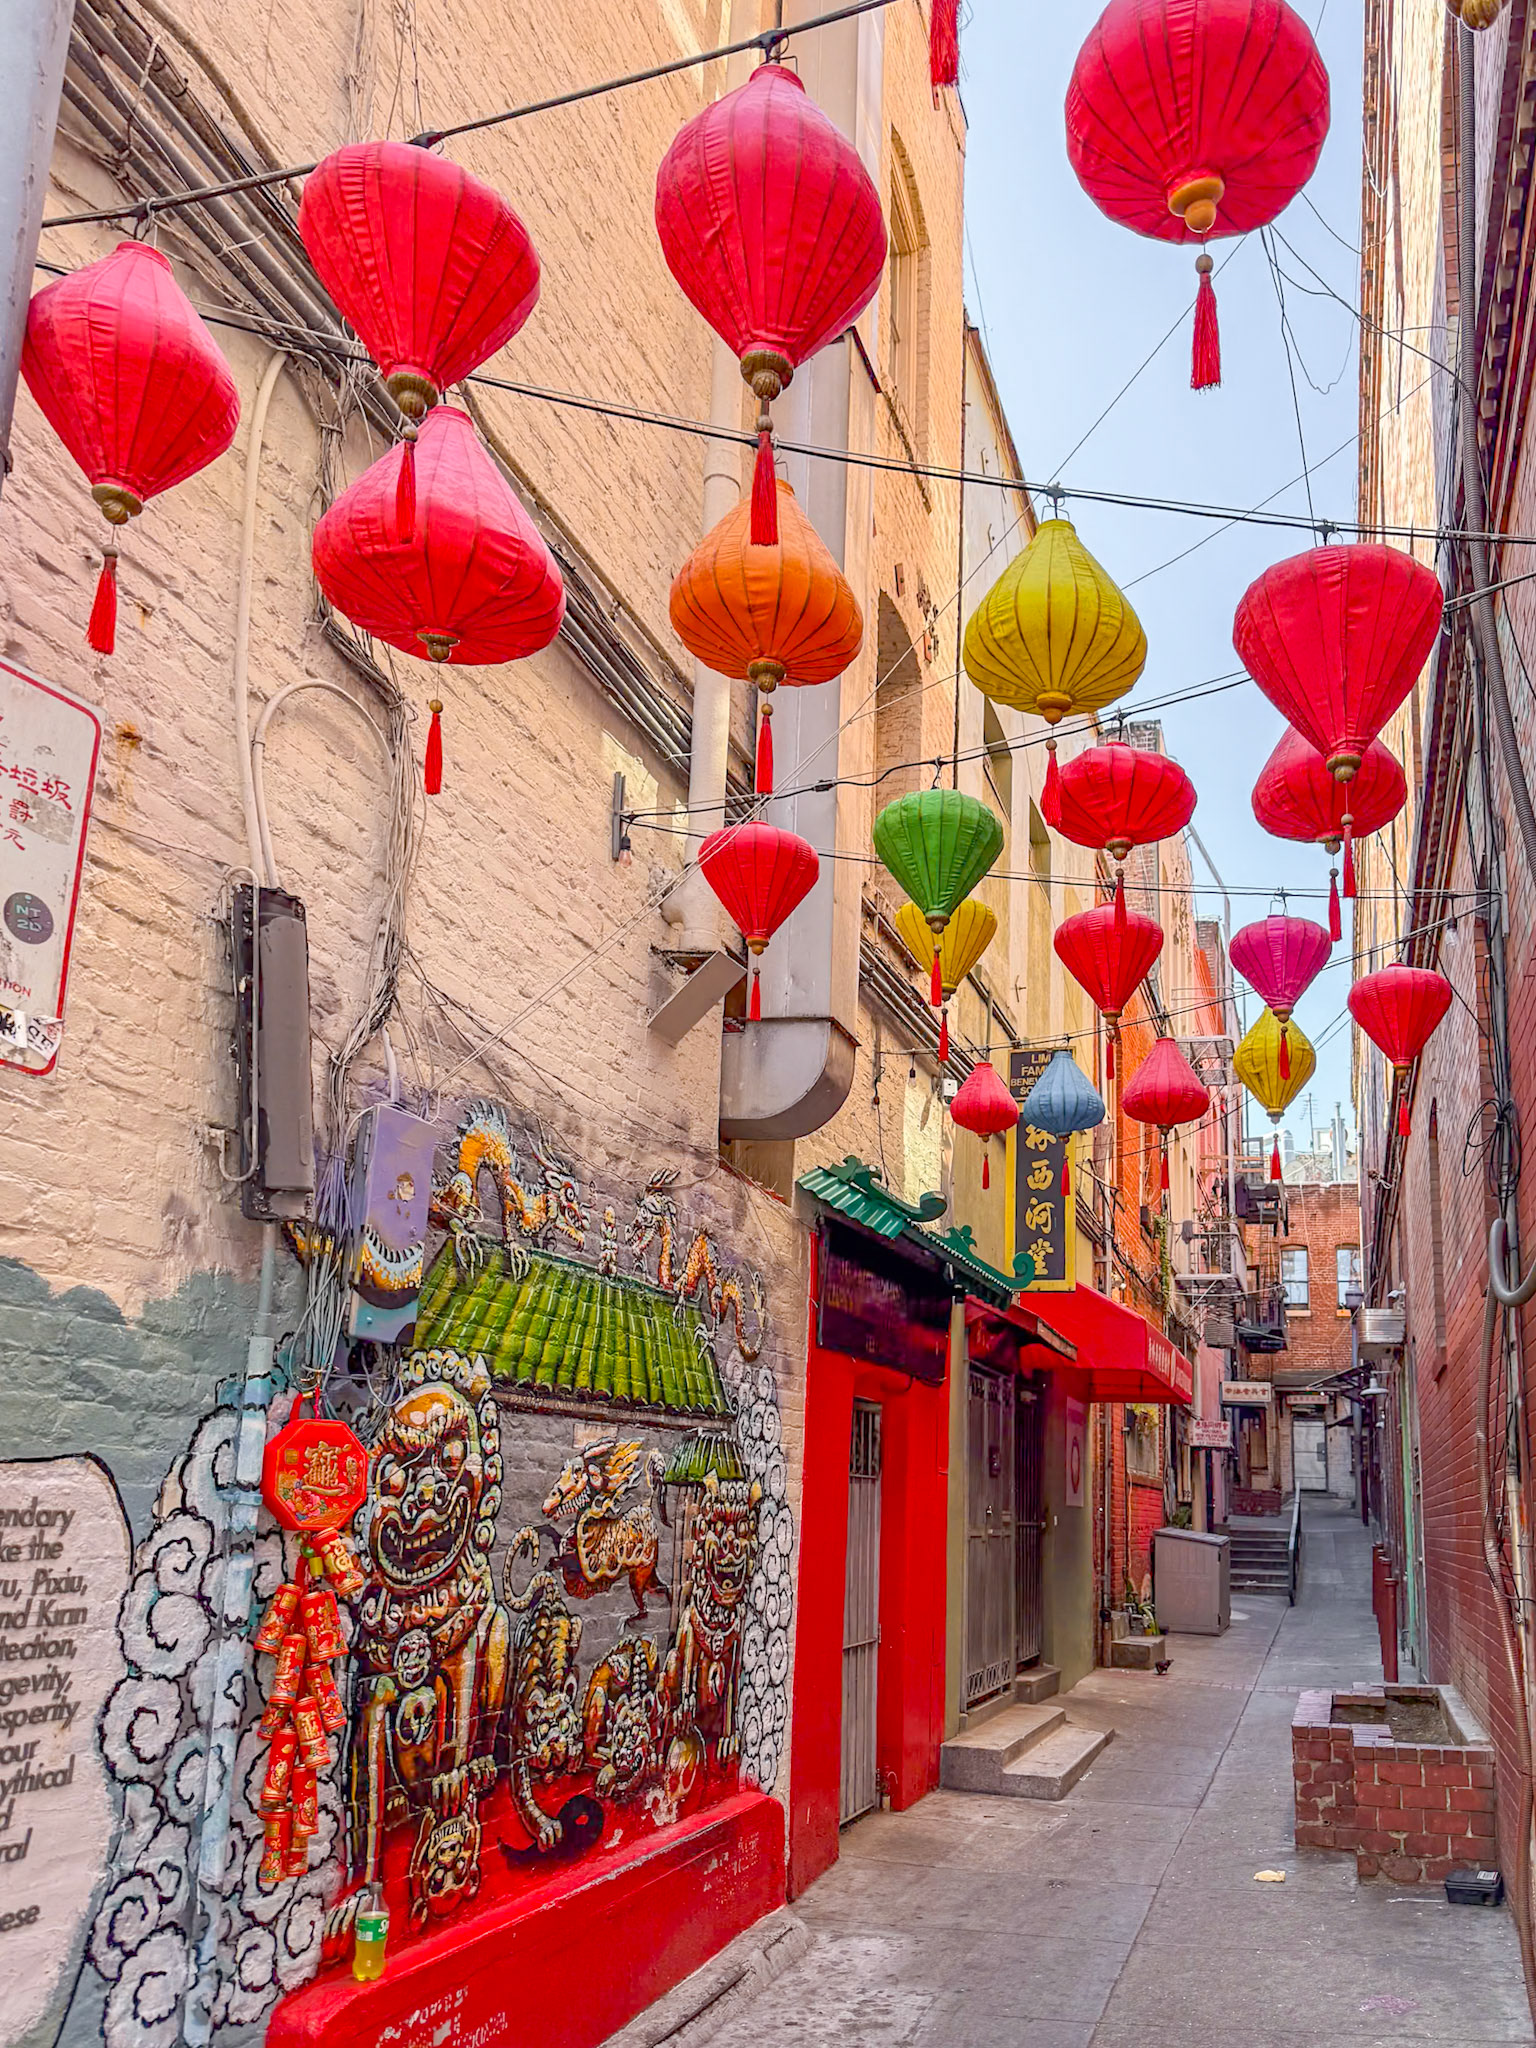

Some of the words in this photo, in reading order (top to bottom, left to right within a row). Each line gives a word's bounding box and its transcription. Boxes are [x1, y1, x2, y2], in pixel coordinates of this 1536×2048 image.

[0, 764, 72, 811] 垃圾
[29, 1529, 64, 1560] the
[31, 1566, 88, 1596] Pixiu,
[0, 1695, 81, 1738] sperity
